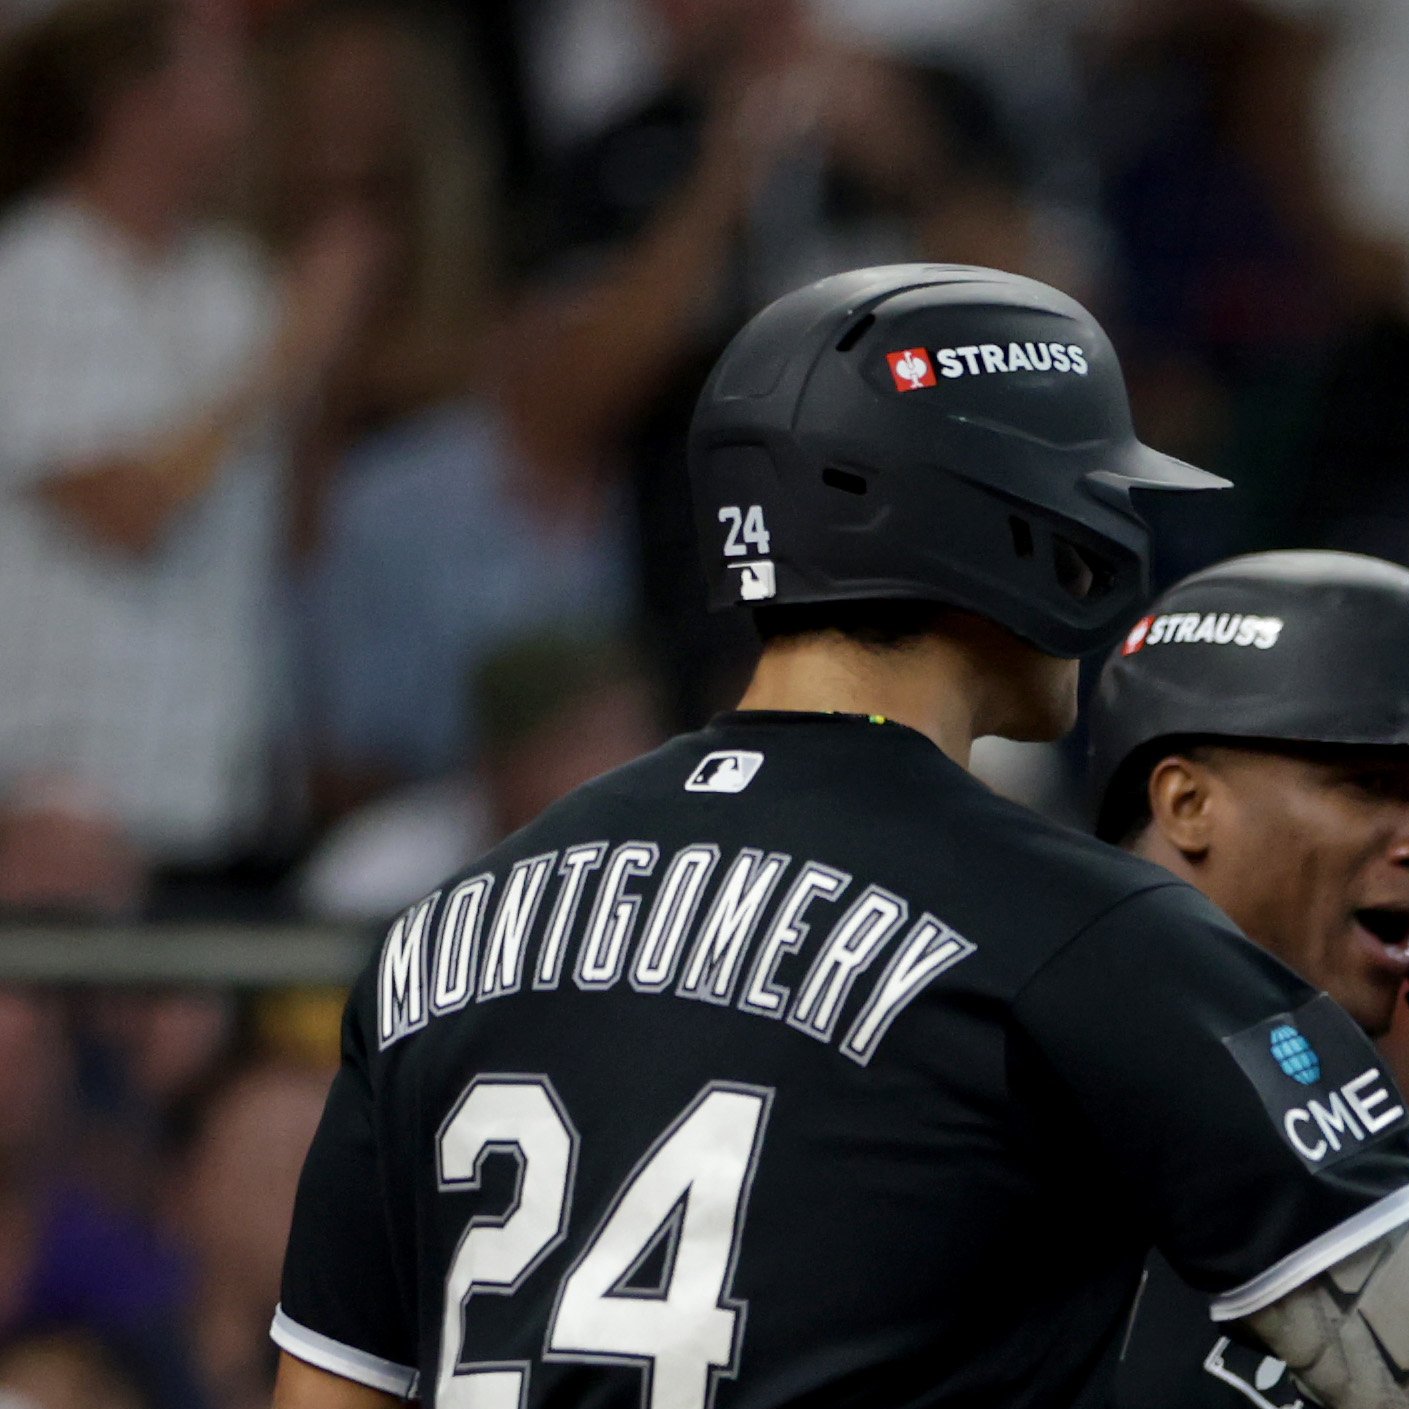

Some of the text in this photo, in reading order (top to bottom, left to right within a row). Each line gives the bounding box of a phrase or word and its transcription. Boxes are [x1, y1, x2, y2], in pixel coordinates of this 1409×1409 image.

[937, 342, 1088, 378] STRAUSS
[718, 505, 770, 556] 24
[1147, 613, 1283, 649] STRAUSS
[378, 840, 977, 1067] MONTGOMERY
[1284, 1067, 1404, 1161] CME
